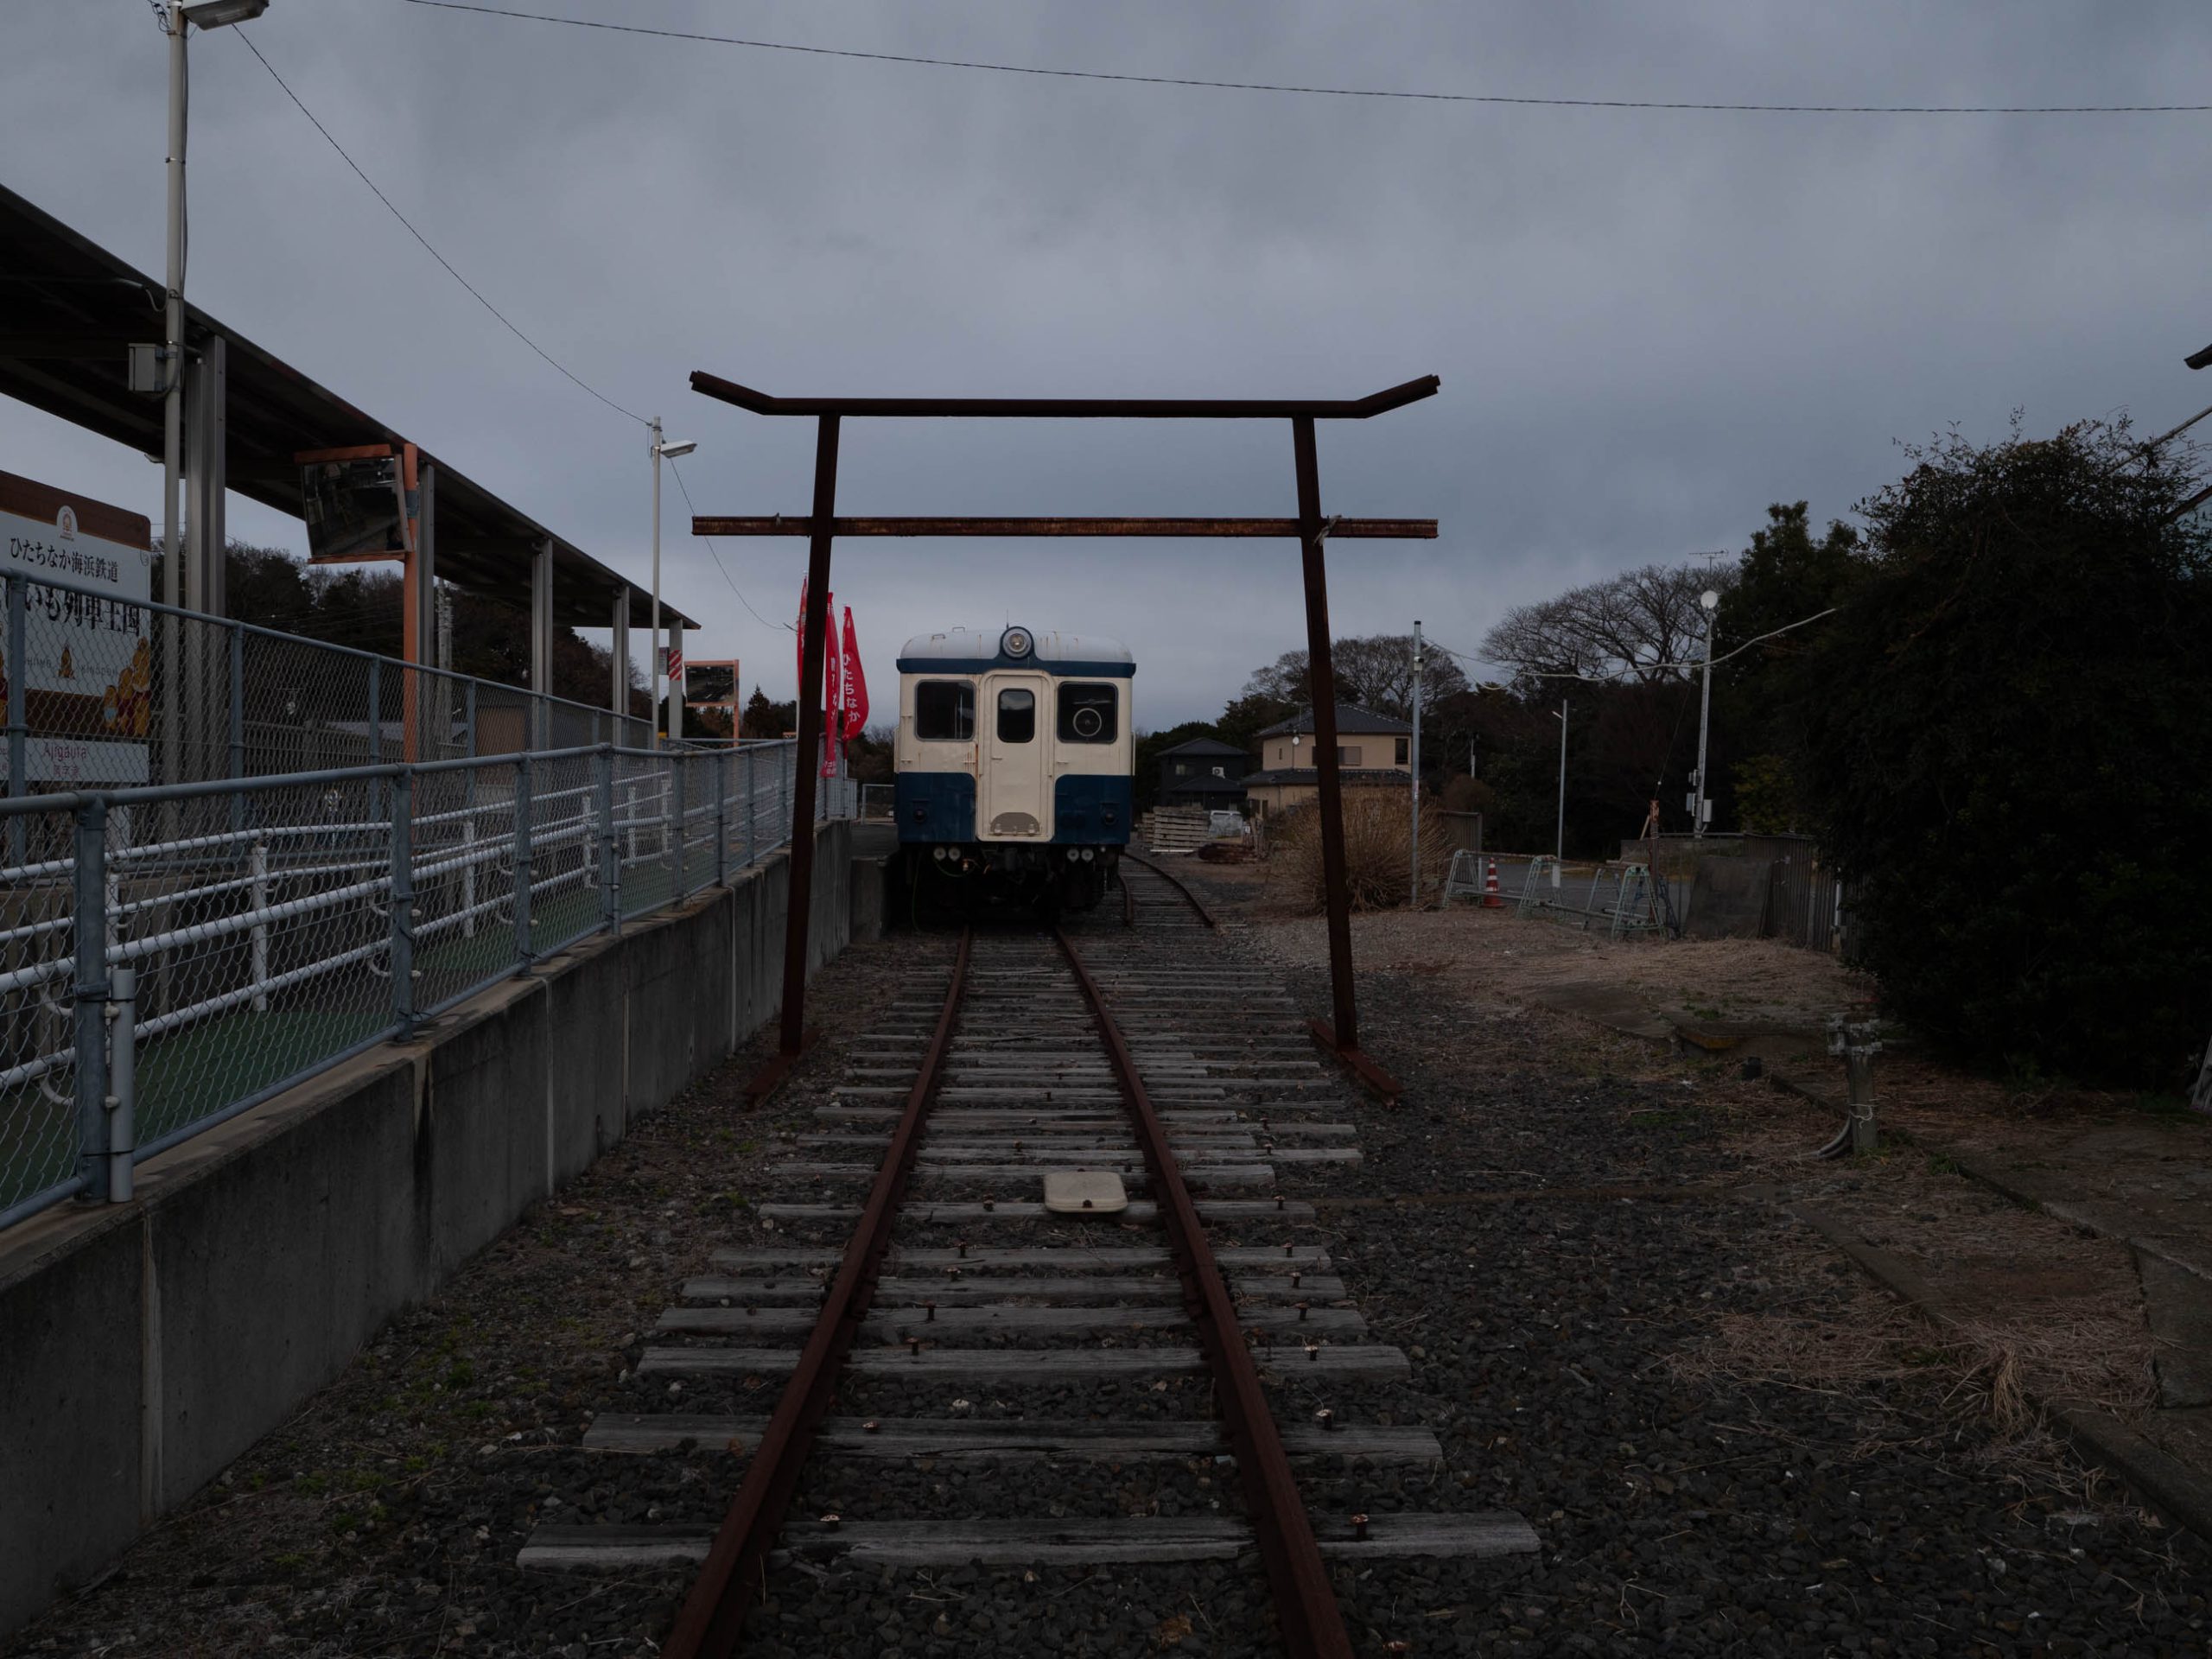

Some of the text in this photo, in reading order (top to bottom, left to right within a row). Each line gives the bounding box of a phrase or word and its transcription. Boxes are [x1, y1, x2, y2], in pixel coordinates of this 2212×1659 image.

[10, 537, 118, 582] ひたちなか海浜鉄道
[6, 581, 140, 637] いも列車王国
